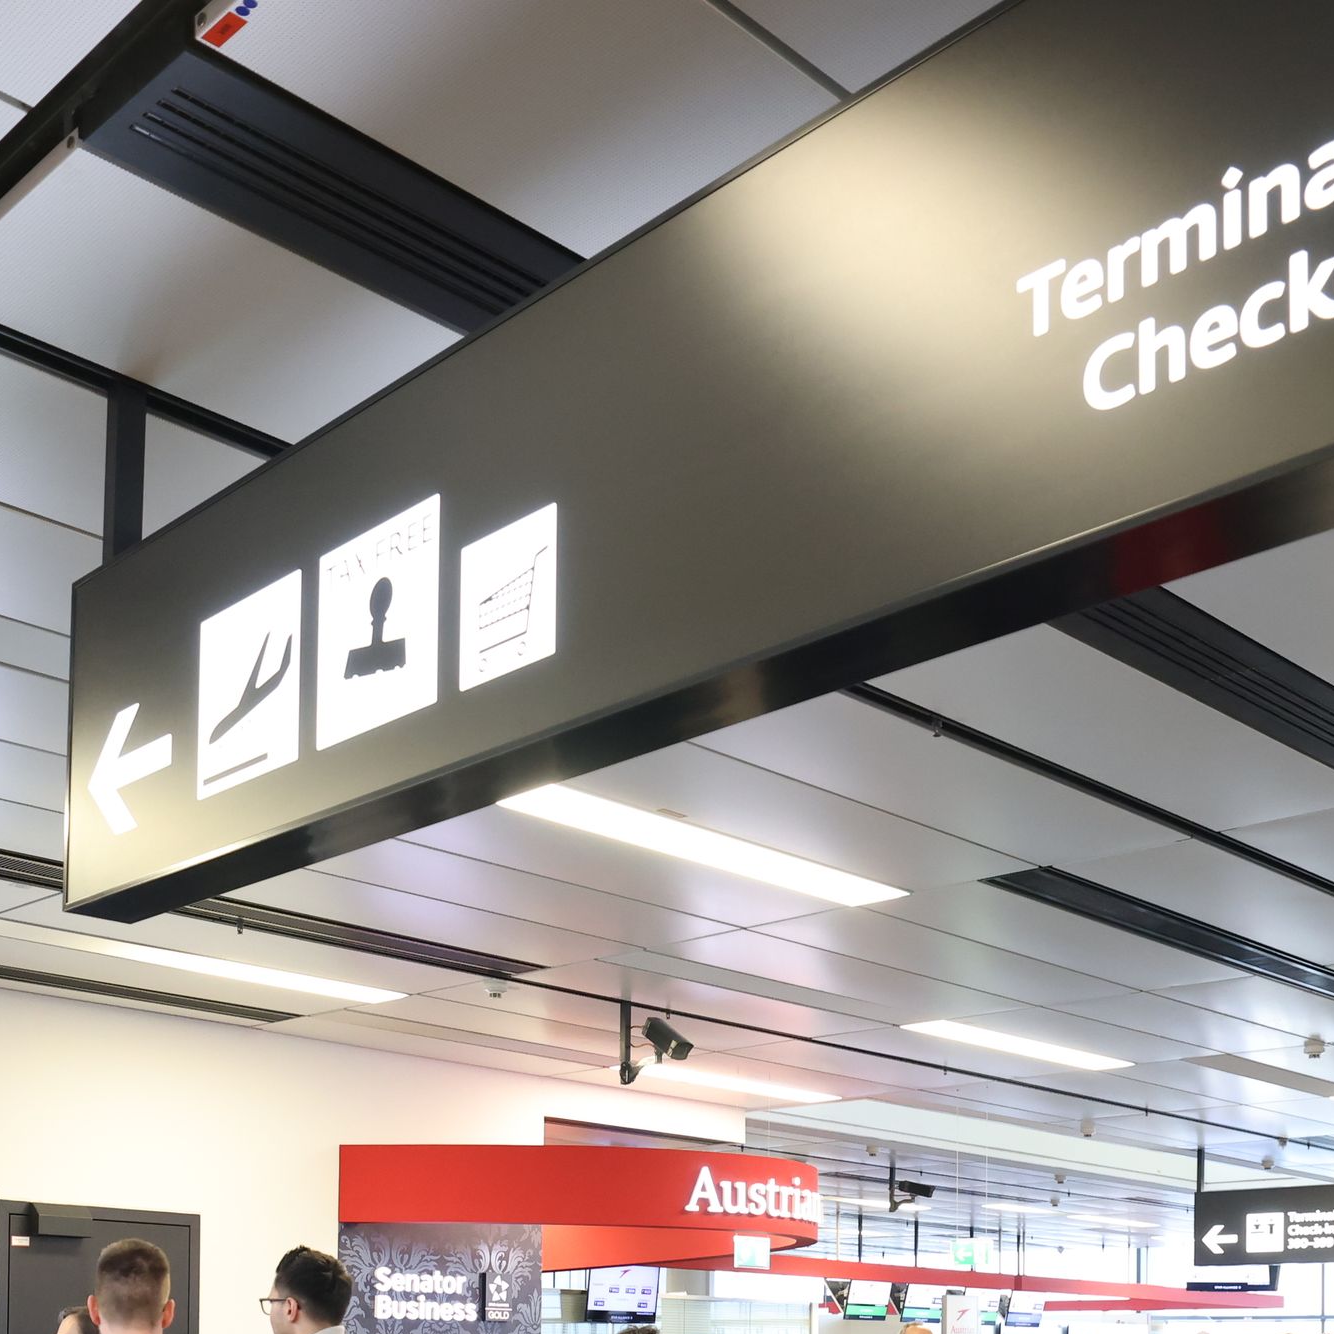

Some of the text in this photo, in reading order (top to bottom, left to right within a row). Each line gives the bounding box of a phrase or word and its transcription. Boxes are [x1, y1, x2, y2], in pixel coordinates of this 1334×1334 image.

[375, 513, 433, 568] FREE
[684, 1166, 824, 1224] Austrian
[374, 1266, 467, 1294] Senator
[373, 1295, 477, 1321] Business
[488, 1311, 509, 1320] GOLD
